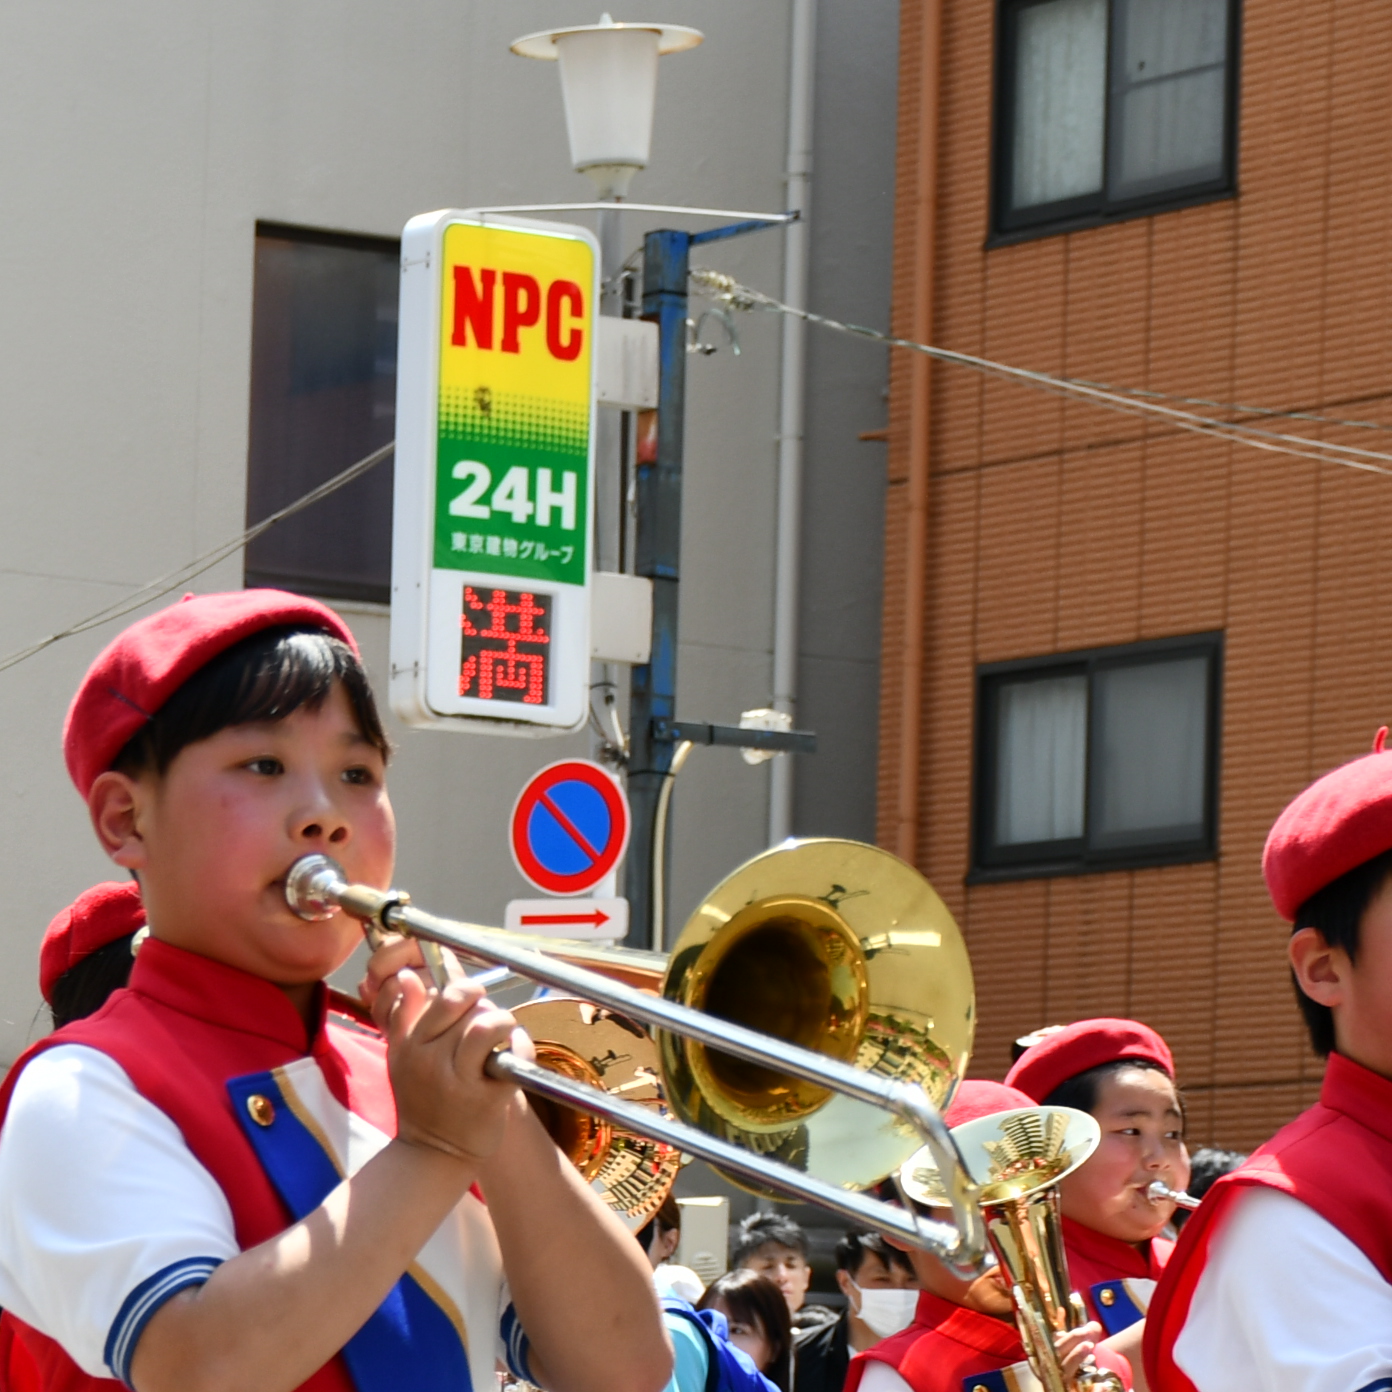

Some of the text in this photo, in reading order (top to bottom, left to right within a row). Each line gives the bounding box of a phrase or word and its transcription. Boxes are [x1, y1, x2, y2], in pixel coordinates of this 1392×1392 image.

[450, 264, 584, 362] NPC
[447, 459, 578, 531] 24H
[450, 531, 575, 565] 東京建物グループ
[458, 585, 549, 705] 満
